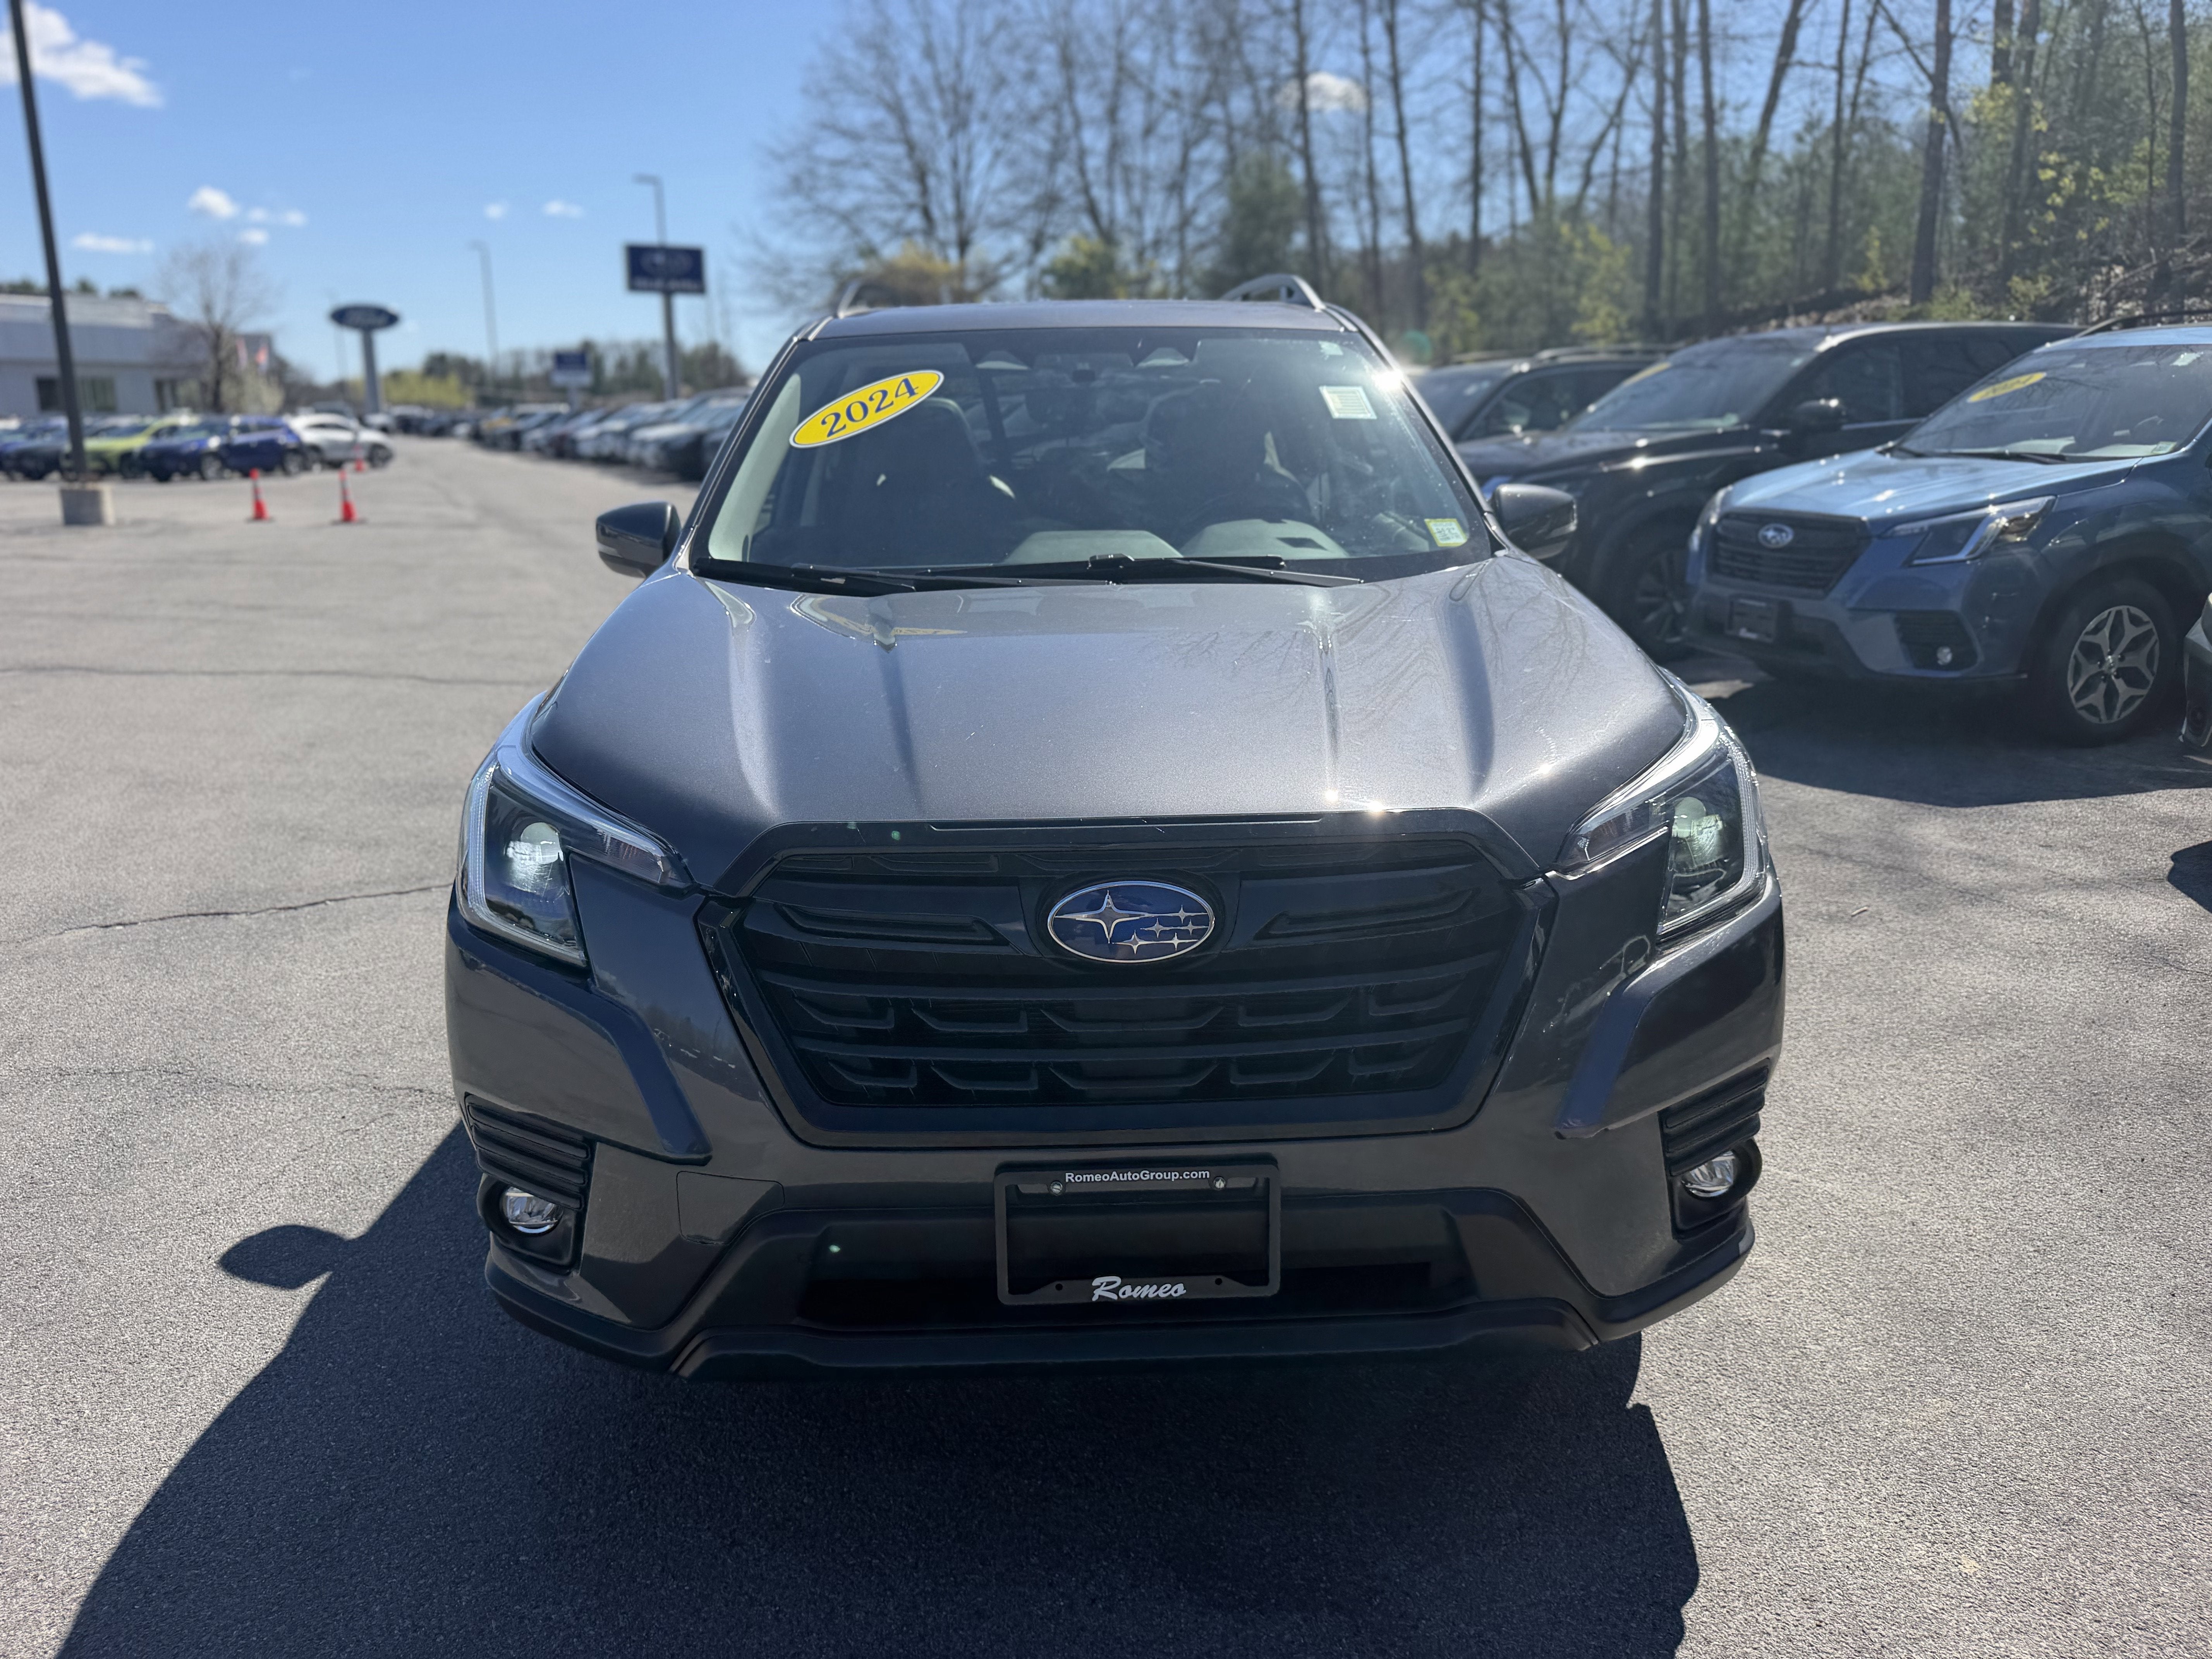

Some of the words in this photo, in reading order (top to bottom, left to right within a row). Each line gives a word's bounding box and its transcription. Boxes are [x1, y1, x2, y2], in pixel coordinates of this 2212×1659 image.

[821, 378, 919, 438] 2024
[1065, 1170, 1210, 1183] RomeoAutoGroup.com
[1091, 1276, 1187, 1302] Romeo
